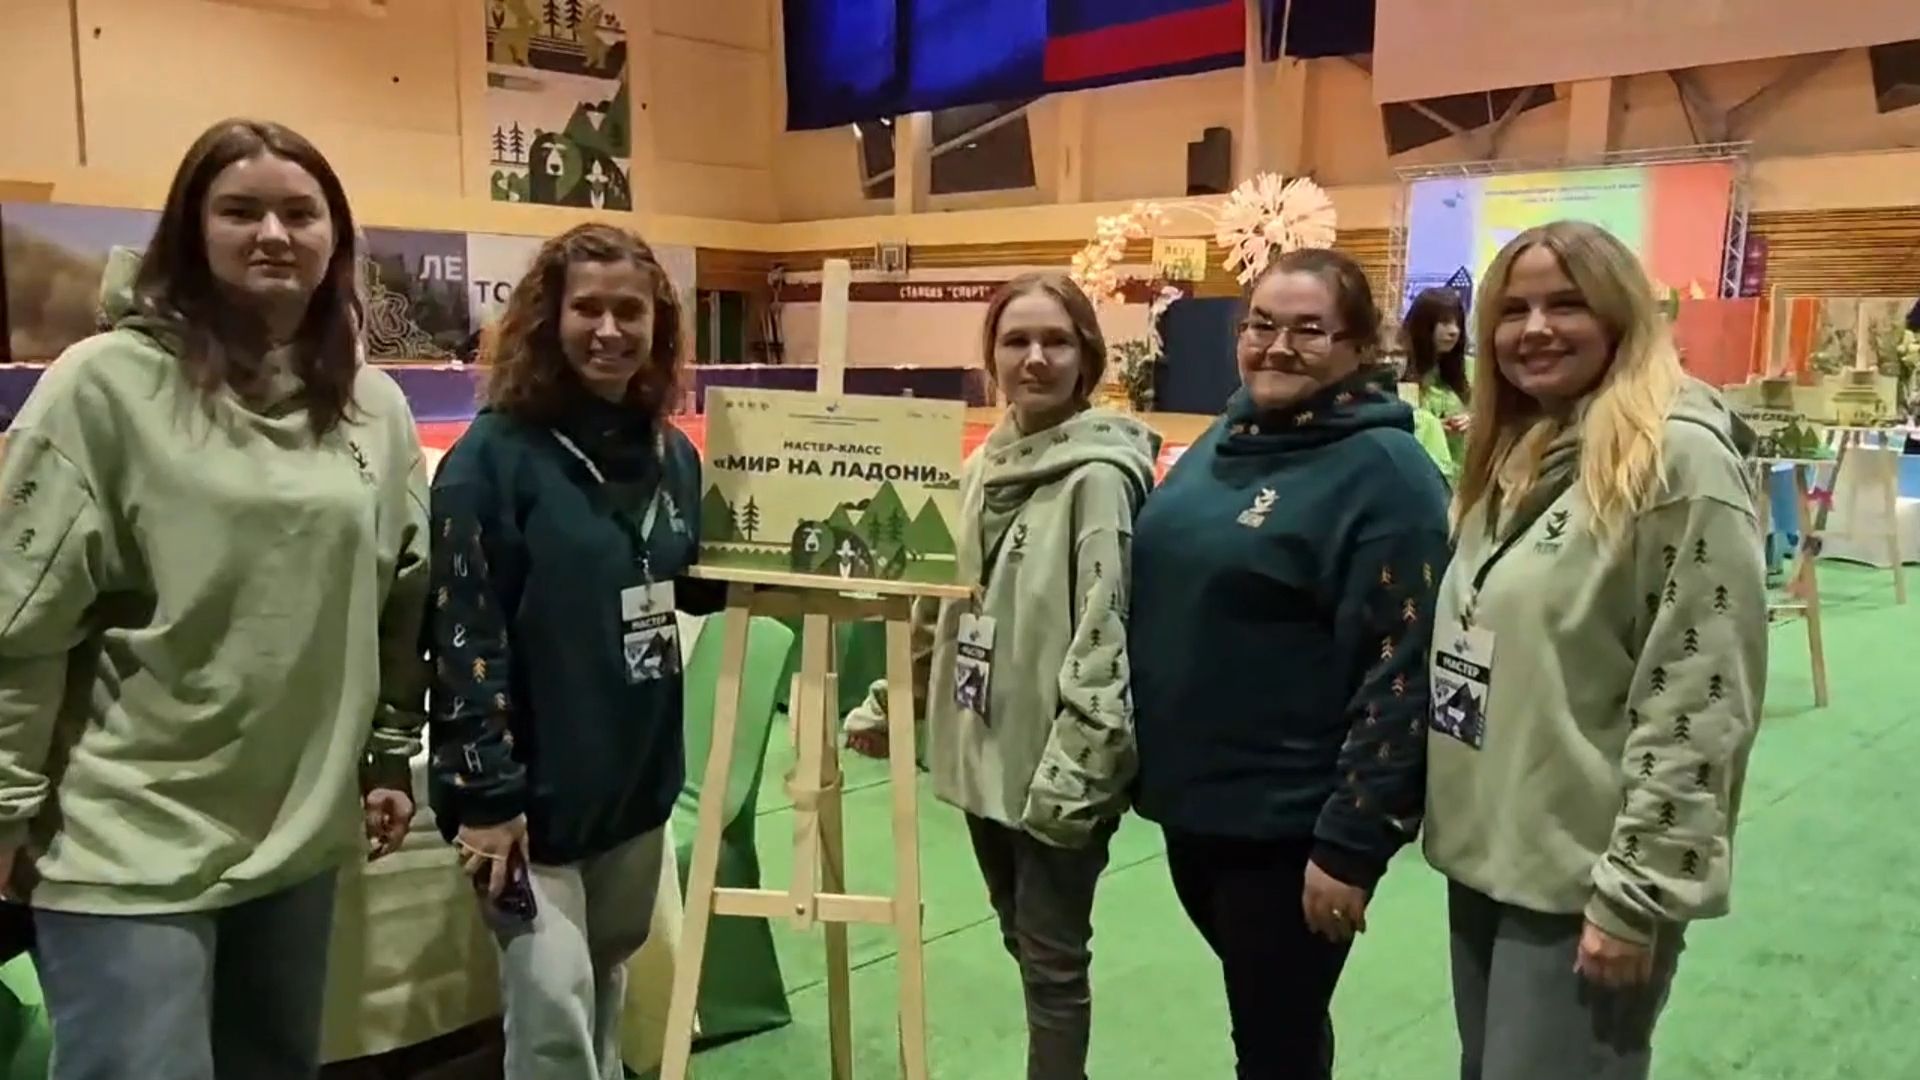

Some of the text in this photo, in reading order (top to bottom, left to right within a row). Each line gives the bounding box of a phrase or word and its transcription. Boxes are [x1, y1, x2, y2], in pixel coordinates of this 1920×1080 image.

[420, 254, 463, 281] ЛЕ
[783, 440, 882, 456] МАСТЕР-КЛАСС
[713, 454, 951, 483] «МИР НА ЛАДОНИ»
[1442, 655, 1480, 679] МАСТЕР
